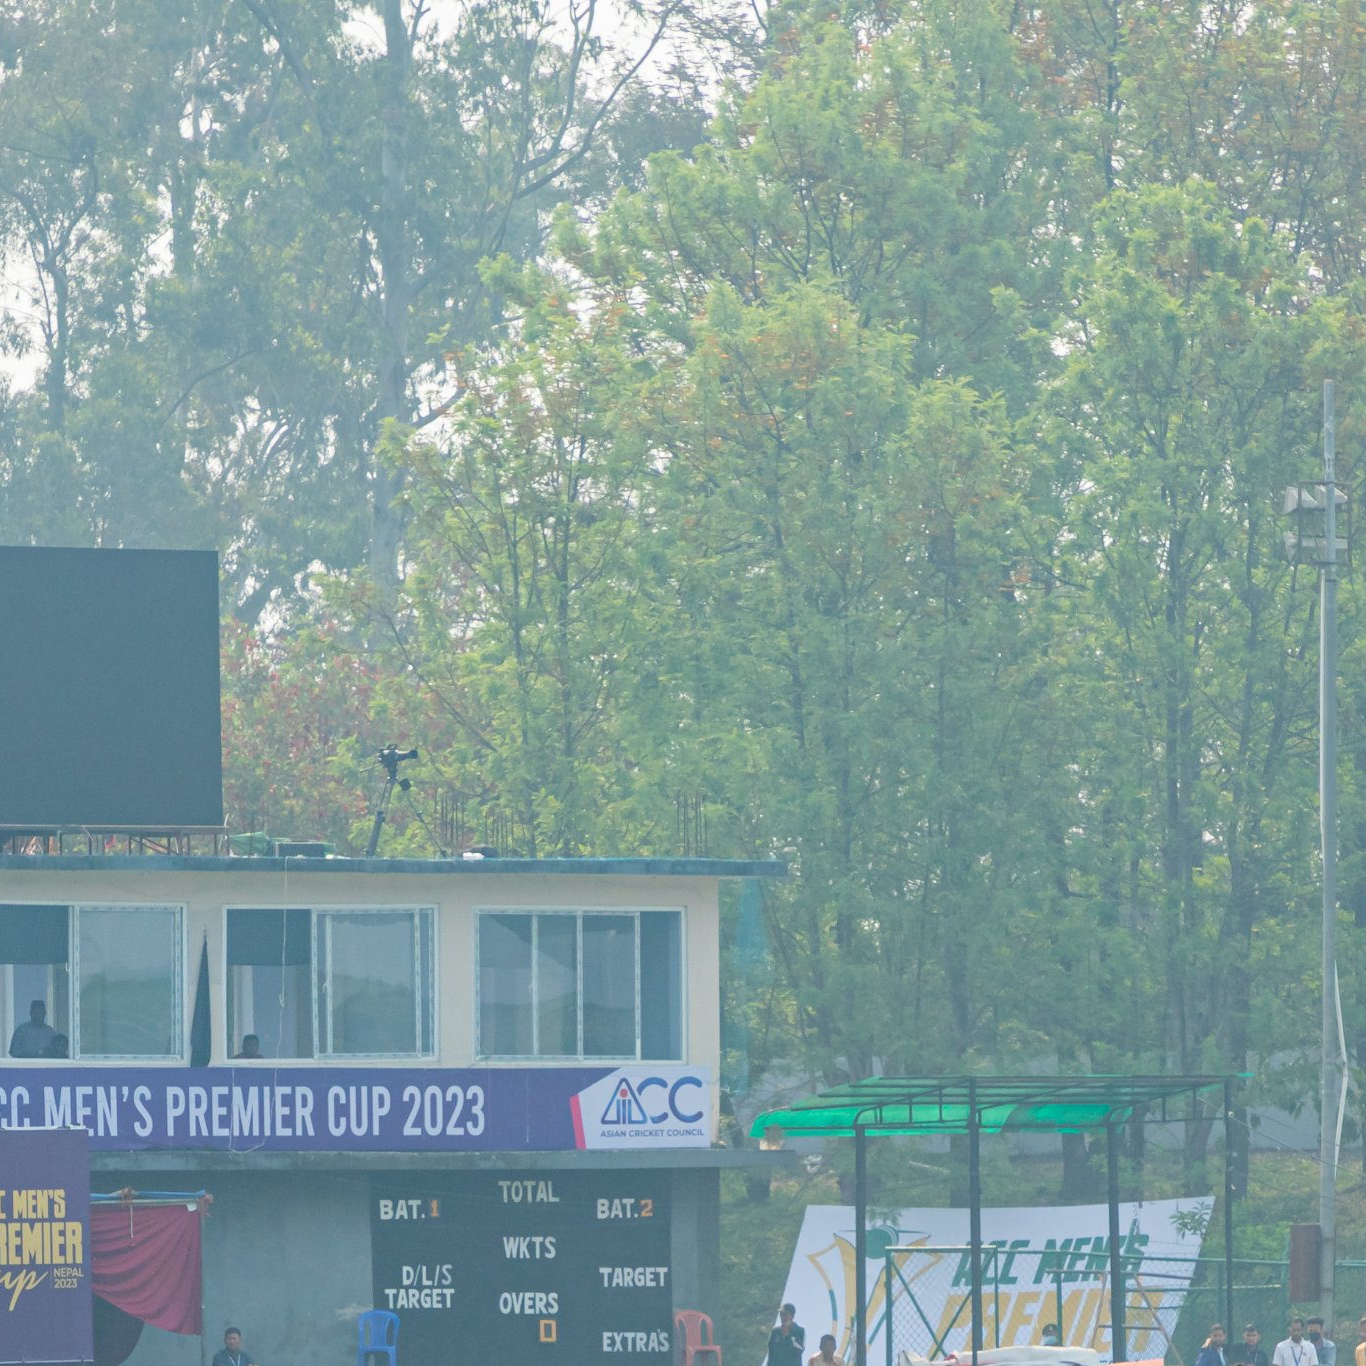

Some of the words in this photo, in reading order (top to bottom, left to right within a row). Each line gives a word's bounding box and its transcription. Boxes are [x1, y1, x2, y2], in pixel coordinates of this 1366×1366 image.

[44, 1086, 153, 1137] MEN'S
[167, 1086, 315, 1137] PREMIER
[328, 1086, 391, 1137] CUP
[403, 1085, 485, 1137] 2023
[601, 1076, 704, 1125] ACC
[600, 1129, 627, 1138] ASIAN
[629, 1129, 664, 1138] CRICKET
[667, 1128, 705, 1137] COUNCIL
[498, 1180, 559, 1202] TOTAL
[13, 1189, 66, 1219] MEN'S
[379, 1200, 425, 1220] BAT.
[503, 1236, 556, 1259] WKTS
[53, 1267, 84, 1277] NEPAL
[402, 1264, 453, 1287] D/L/S
[599, 1267, 668, 1288] TARGET
[53, 1279, 78, 1289] 2023
[385, 1288, 455, 1309] TARGET
[499, 1292, 559, 1315] OVERS
